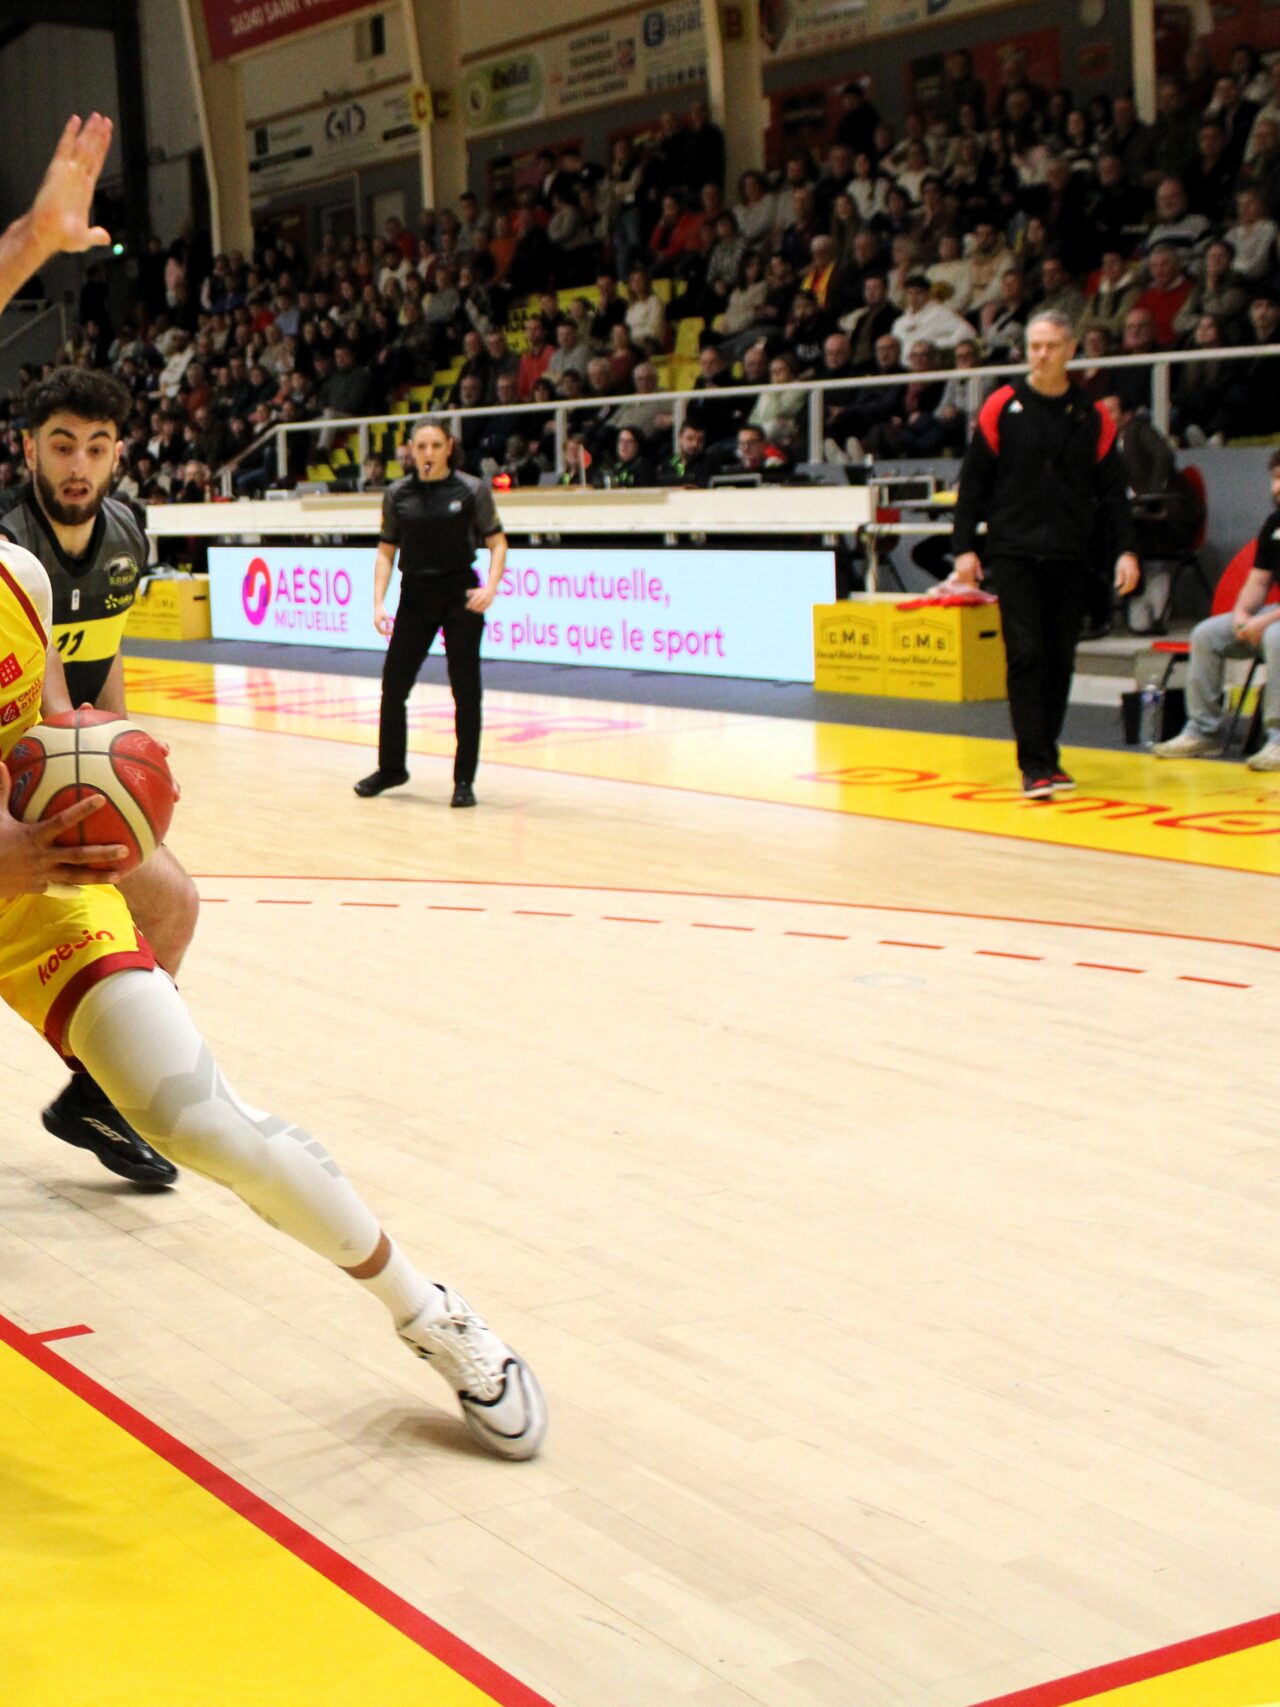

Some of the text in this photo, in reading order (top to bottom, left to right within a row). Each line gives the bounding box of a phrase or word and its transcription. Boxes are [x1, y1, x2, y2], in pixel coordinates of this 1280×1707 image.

[275, 565, 352, 606] AÉSIO
[548, 568, 671, 608] mutuelle,
[274, 608, 350, 633] MUTUELLE
[511, 615, 559, 651] plus
[566, 622, 614, 656] que
[622, 618, 644, 652] le
[651, 626, 727, 662] sport
[57, 630, 85, 656] 11
